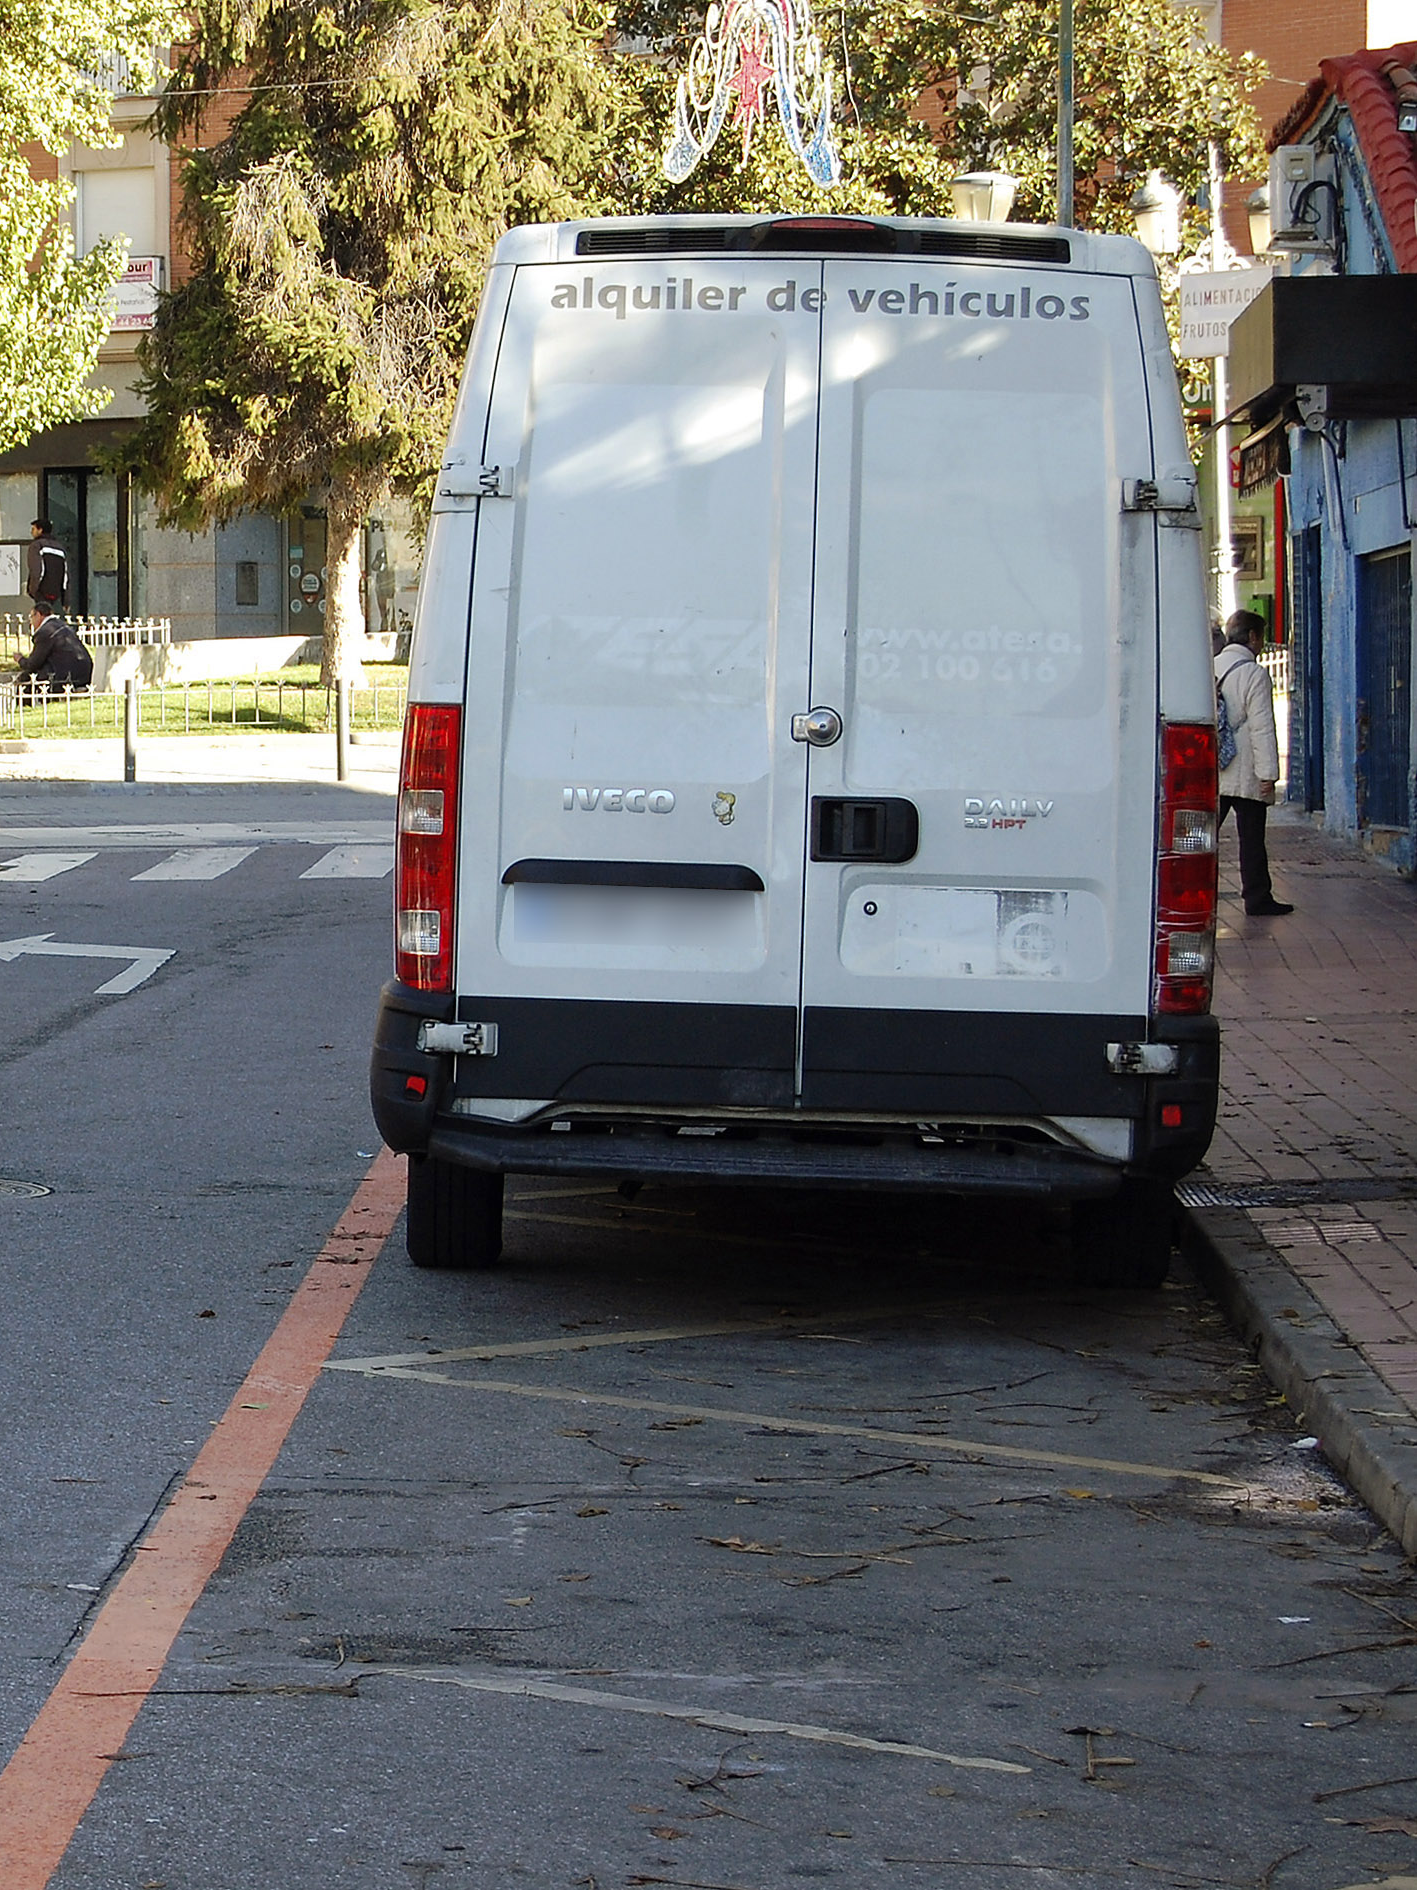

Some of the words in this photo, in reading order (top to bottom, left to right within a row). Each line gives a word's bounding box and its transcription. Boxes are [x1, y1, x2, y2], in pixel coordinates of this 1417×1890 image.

[127, 263, 148, 273] our
[550, 276, 747, 320] alquiler
[766, 279, 828, 313] de
[847, 281, 1091, 321] vehículos
[1182, 321, 1228, 340] FRUTOS
[919, 653, 980, 681] 100
[562, 786, 676, 814] IVECO
[964, 797, 1054, 818] DAILY
[991, 818, 1027, 830] HPT
